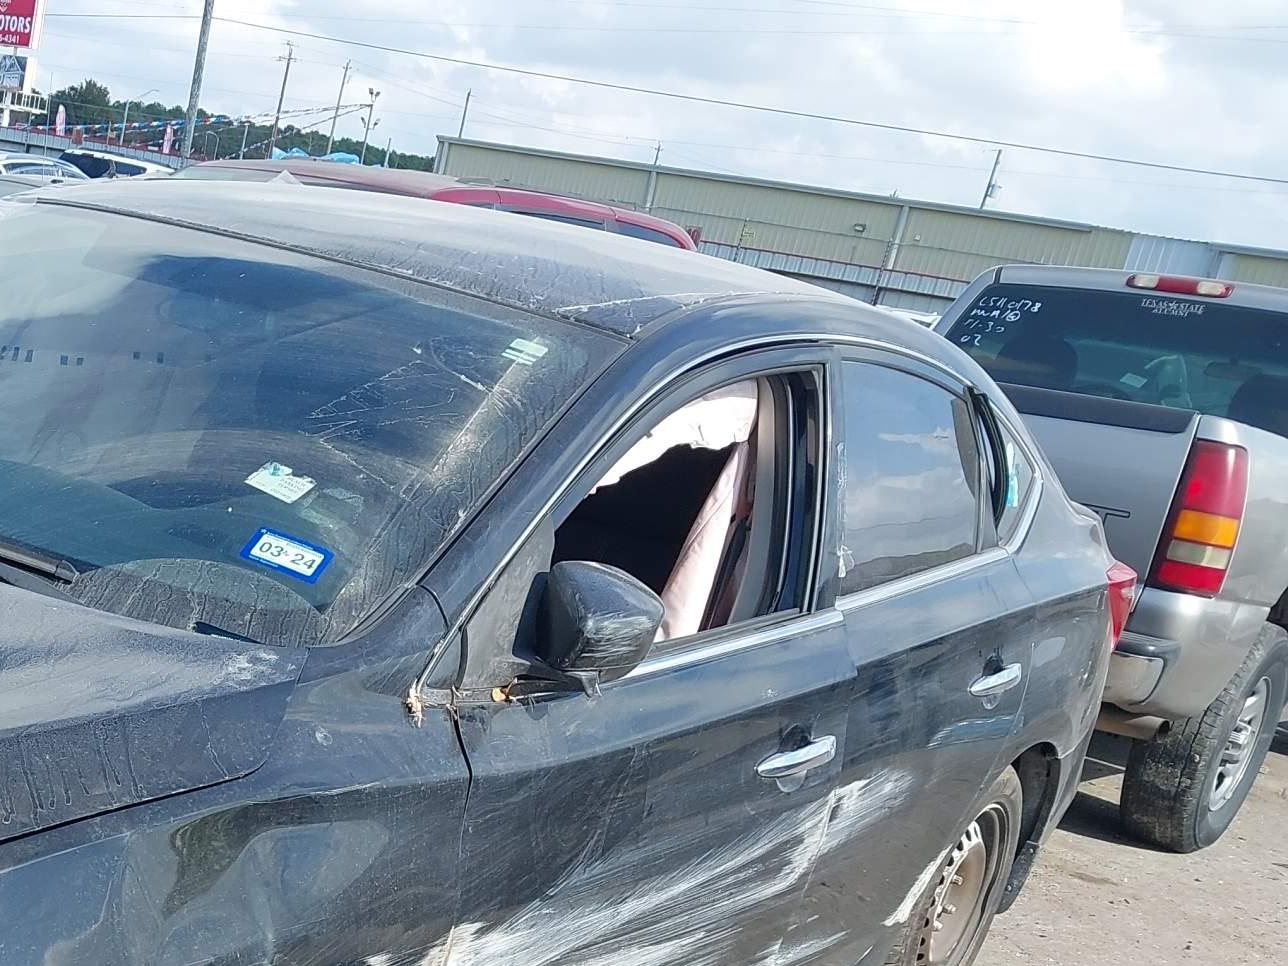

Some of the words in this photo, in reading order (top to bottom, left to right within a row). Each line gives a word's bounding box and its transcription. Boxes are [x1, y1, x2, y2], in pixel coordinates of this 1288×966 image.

[1141, 298, 1169, 309] TEXAS
[1179, 302, 1206, 314] STATE
[1152, 307, 1189, 317] ALUMNI
[259, 541, 284, 558] 03
[290, 553, 317, 571] 24
